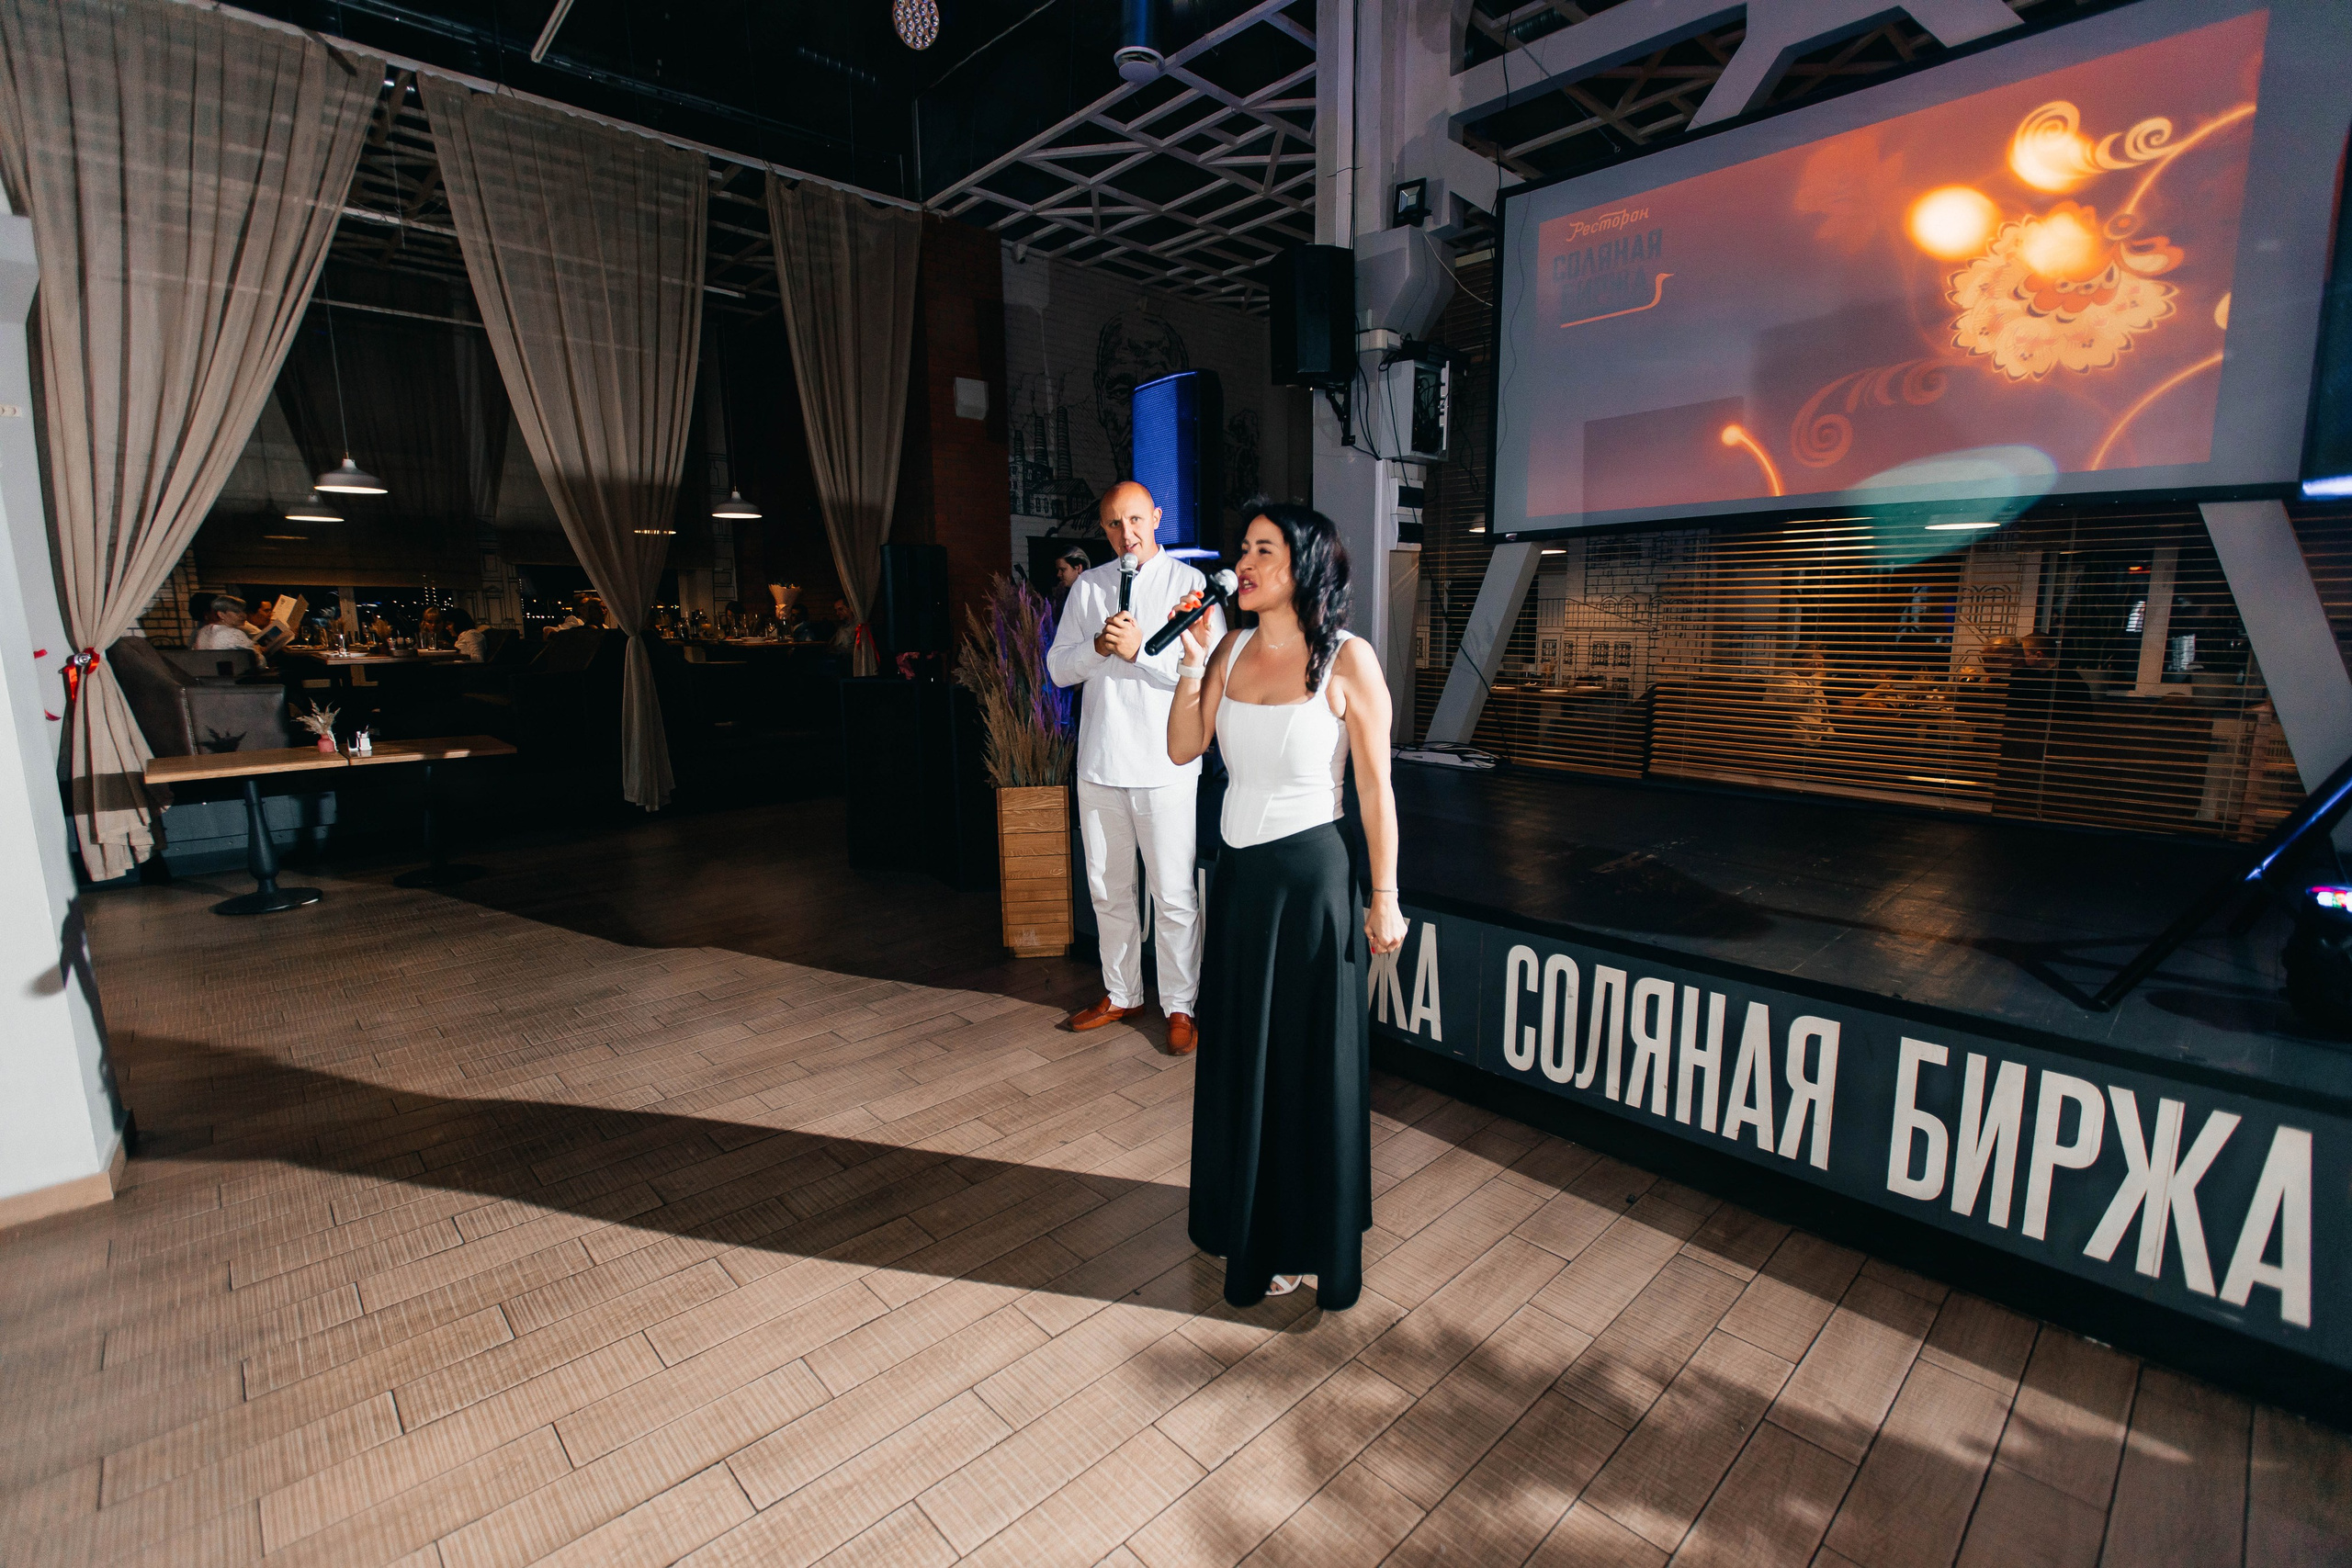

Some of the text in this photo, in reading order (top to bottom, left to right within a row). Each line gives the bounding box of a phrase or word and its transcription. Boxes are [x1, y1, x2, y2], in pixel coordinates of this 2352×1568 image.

[1566, 207, 1650, 243] Ресторан
[1552, 227, 1664, 283] СОЛЯНАЯ
[1503, 943, 1841, 1171] СОЛЯНАЯ
[1886, 1035, 2313, 1328] БИРЖА
